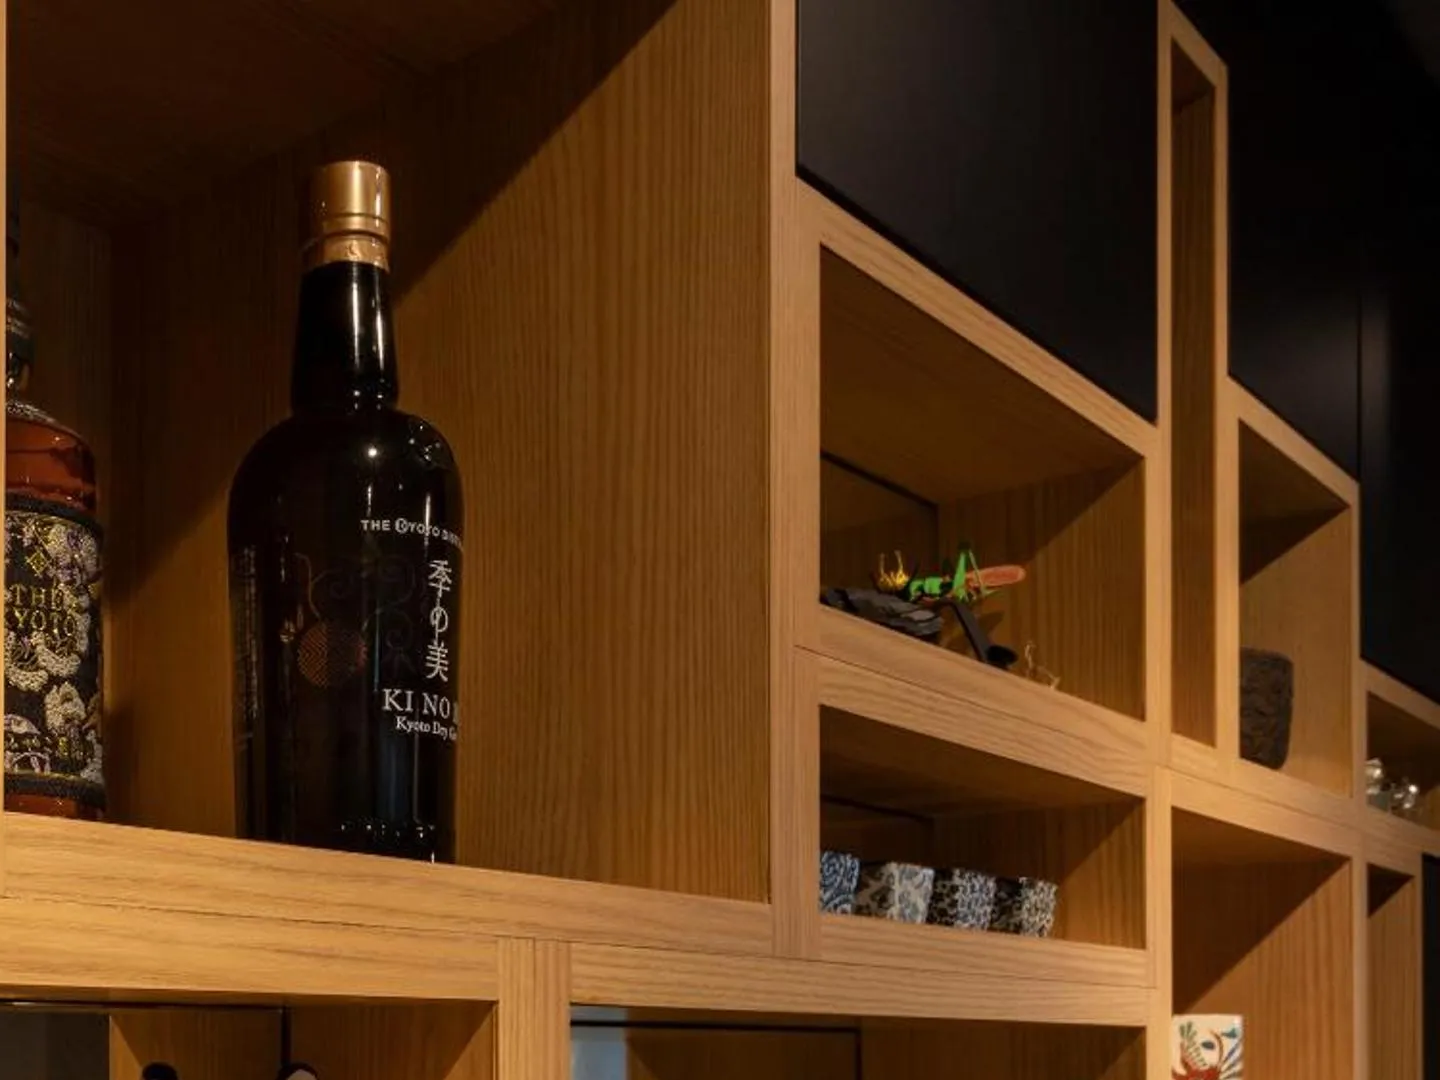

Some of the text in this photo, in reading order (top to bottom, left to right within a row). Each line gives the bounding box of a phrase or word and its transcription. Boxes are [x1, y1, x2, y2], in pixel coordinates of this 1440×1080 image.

[360, 519, 391, 532] THE
[11, 606, 77, 636] YOTO
[426, 559, 452, 682] 季の美
[382, 688, 415, 713] KI
[422, 692, 451, 719] NO
[395, 715, 431, 733] Kyoto
